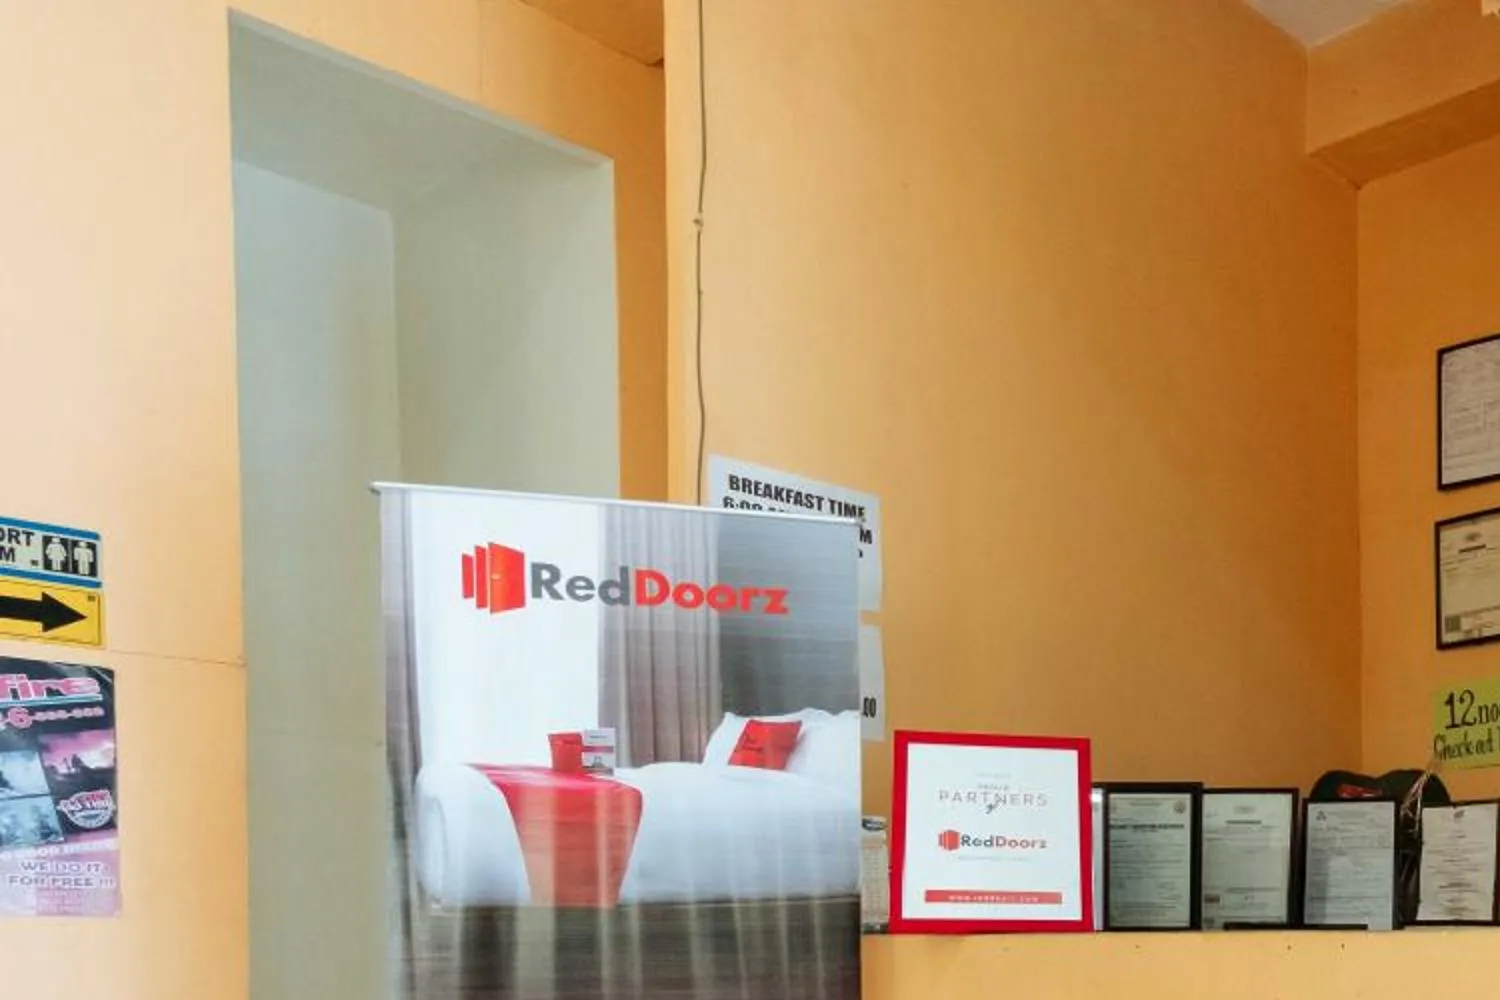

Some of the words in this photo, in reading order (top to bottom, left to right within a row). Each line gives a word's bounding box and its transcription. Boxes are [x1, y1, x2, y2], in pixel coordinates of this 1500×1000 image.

[728, 473, 825, 511] BREAKFAST
[827, 498, 866, 521] TIME
[530, 562, 790, 615] RedDoorz
[1444, 689, 1477, 729] 12
[939, 789, 1047, 807] PARTNERS
[961, 834, 1047, 849] RedDoorz
